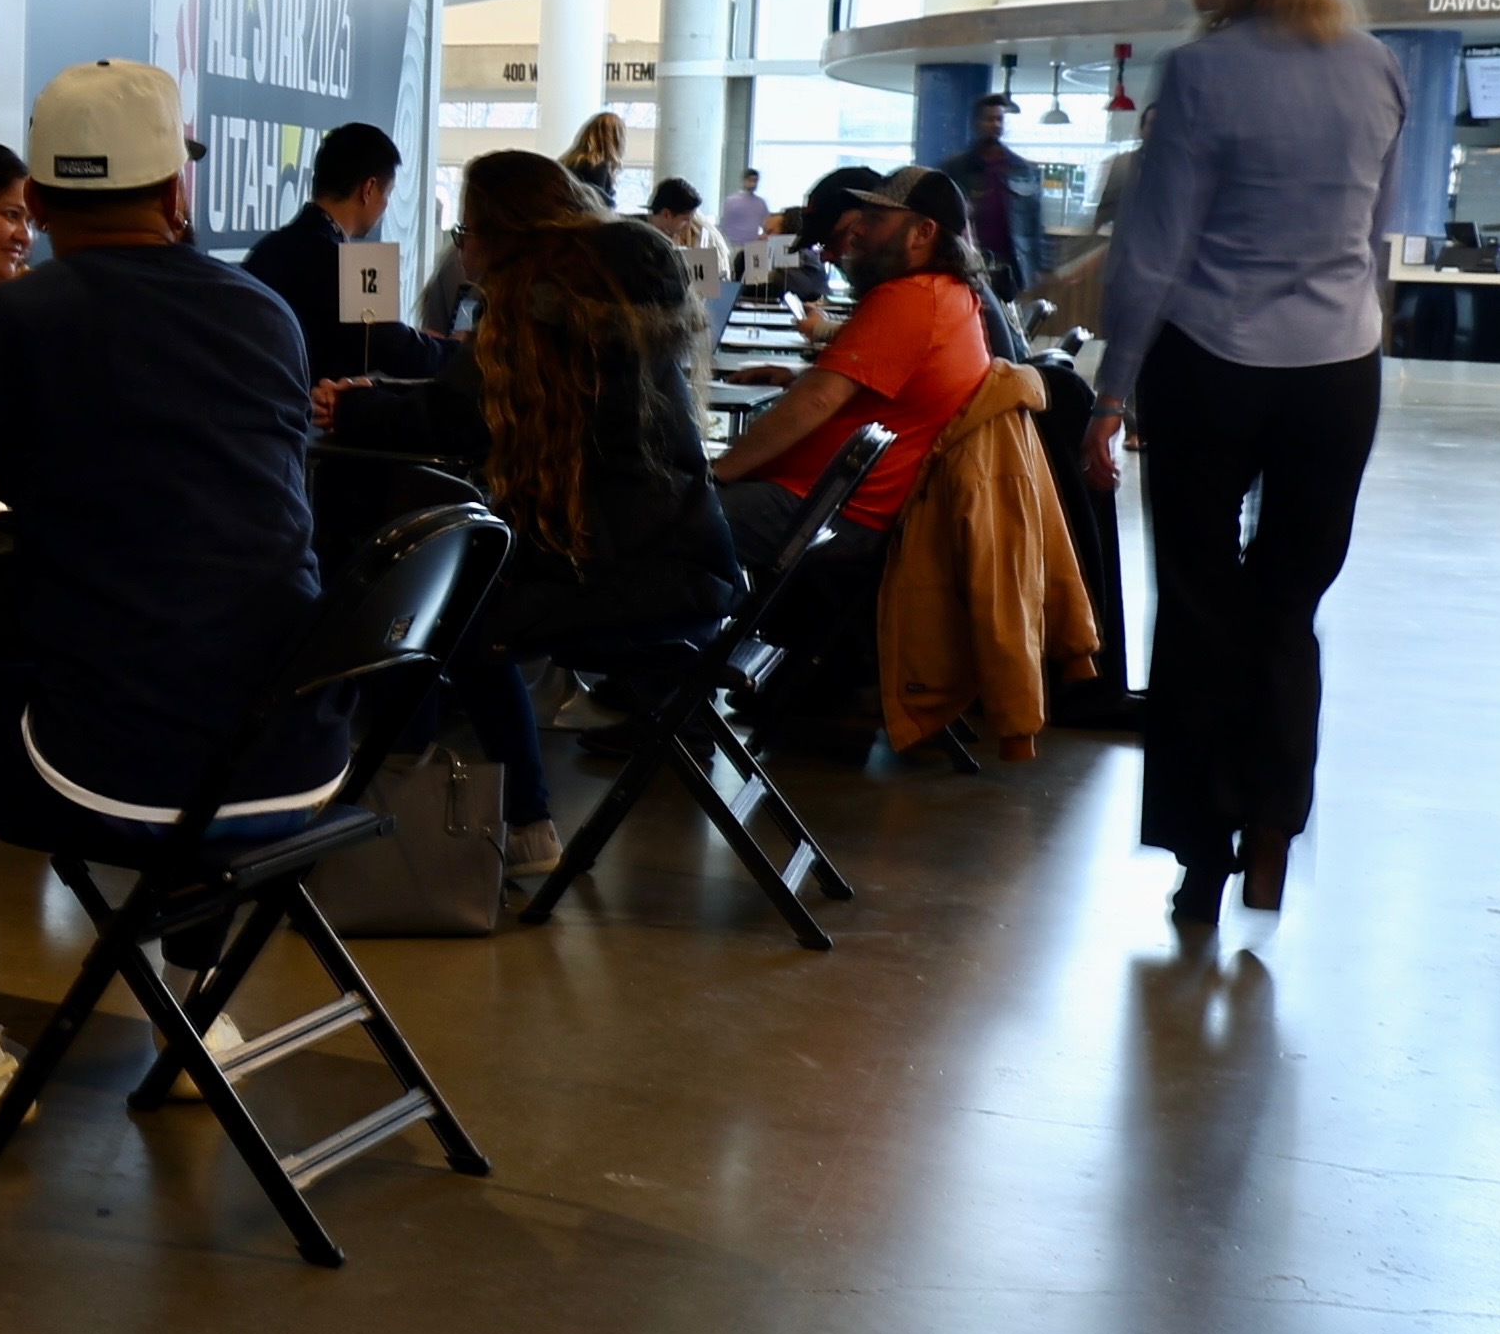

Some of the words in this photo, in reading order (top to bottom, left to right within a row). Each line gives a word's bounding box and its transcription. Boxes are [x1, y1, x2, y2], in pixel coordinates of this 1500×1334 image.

[503, 62, 525, 82] 400
[209, 114, 279, 233] UTAH
[361, 268, 377, 293] 12
